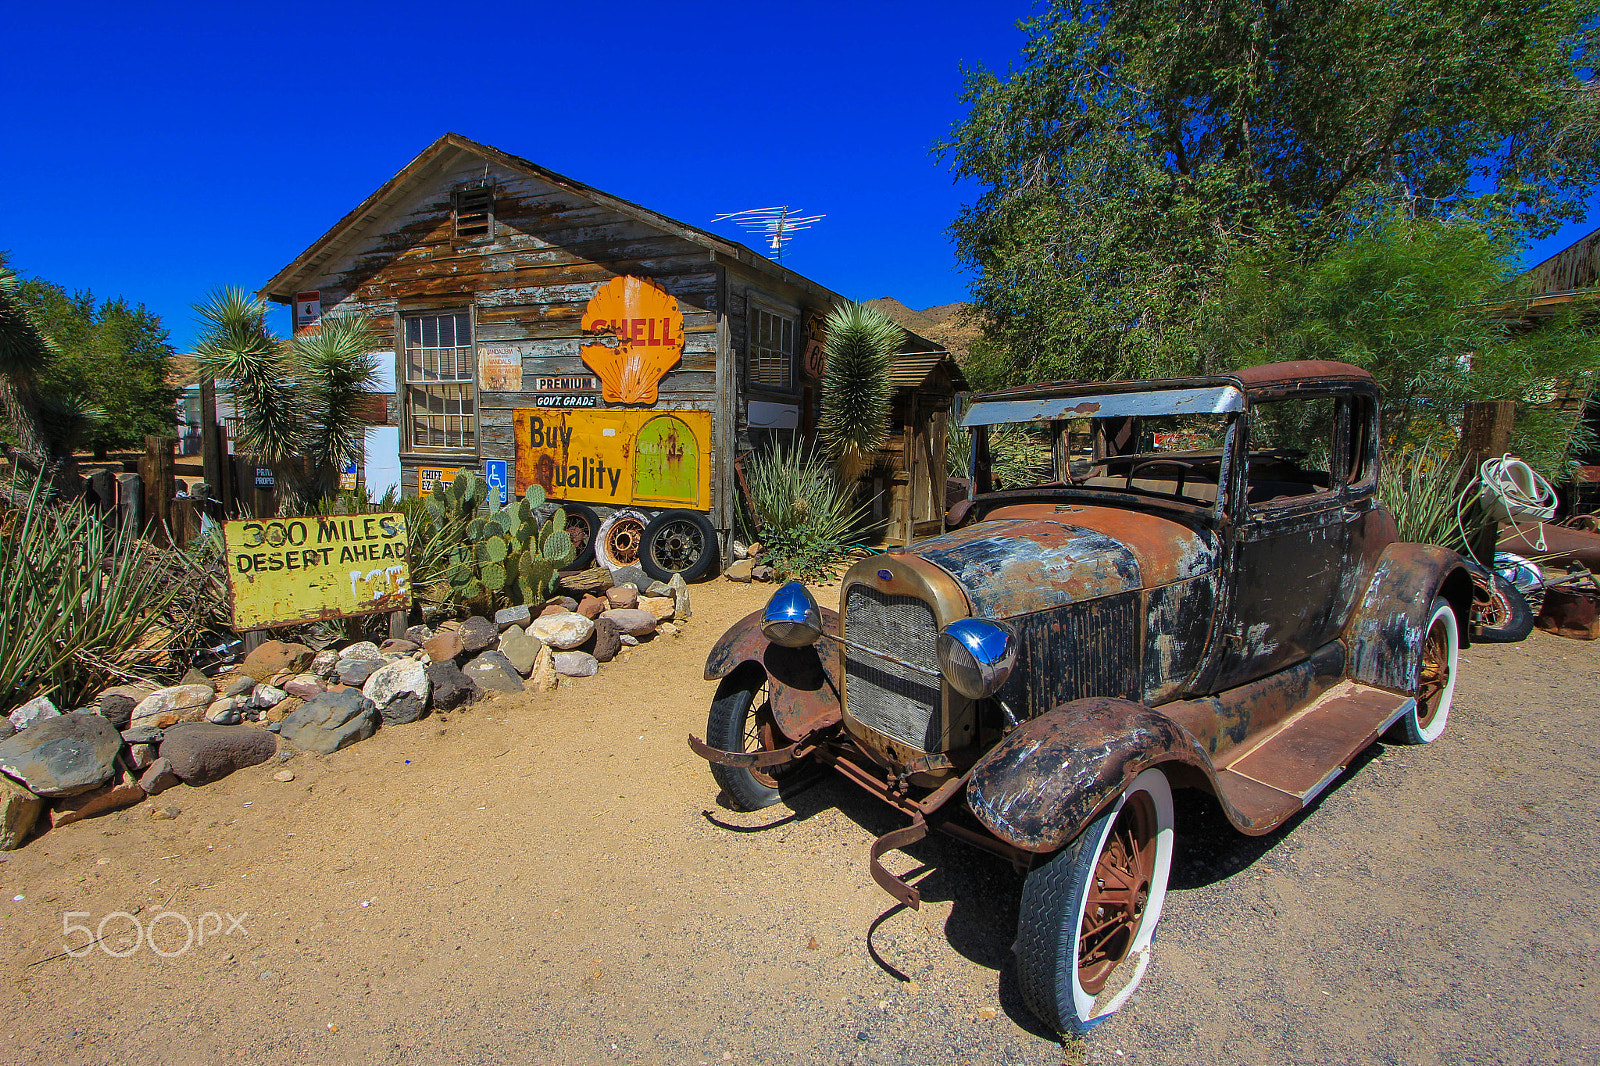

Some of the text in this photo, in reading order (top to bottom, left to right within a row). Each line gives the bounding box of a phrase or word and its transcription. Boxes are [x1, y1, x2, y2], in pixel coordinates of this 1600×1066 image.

[540, 378, 592, 389] PREMIUM
[563, 396, 596, 406] GRADE
[529, 415, 573, 456] Buy
[537, 454, 621, 496] Quality
[243, 516, 402, 548] 300 MILES
[236, 542, 407, 573] DESERT AHEAD
